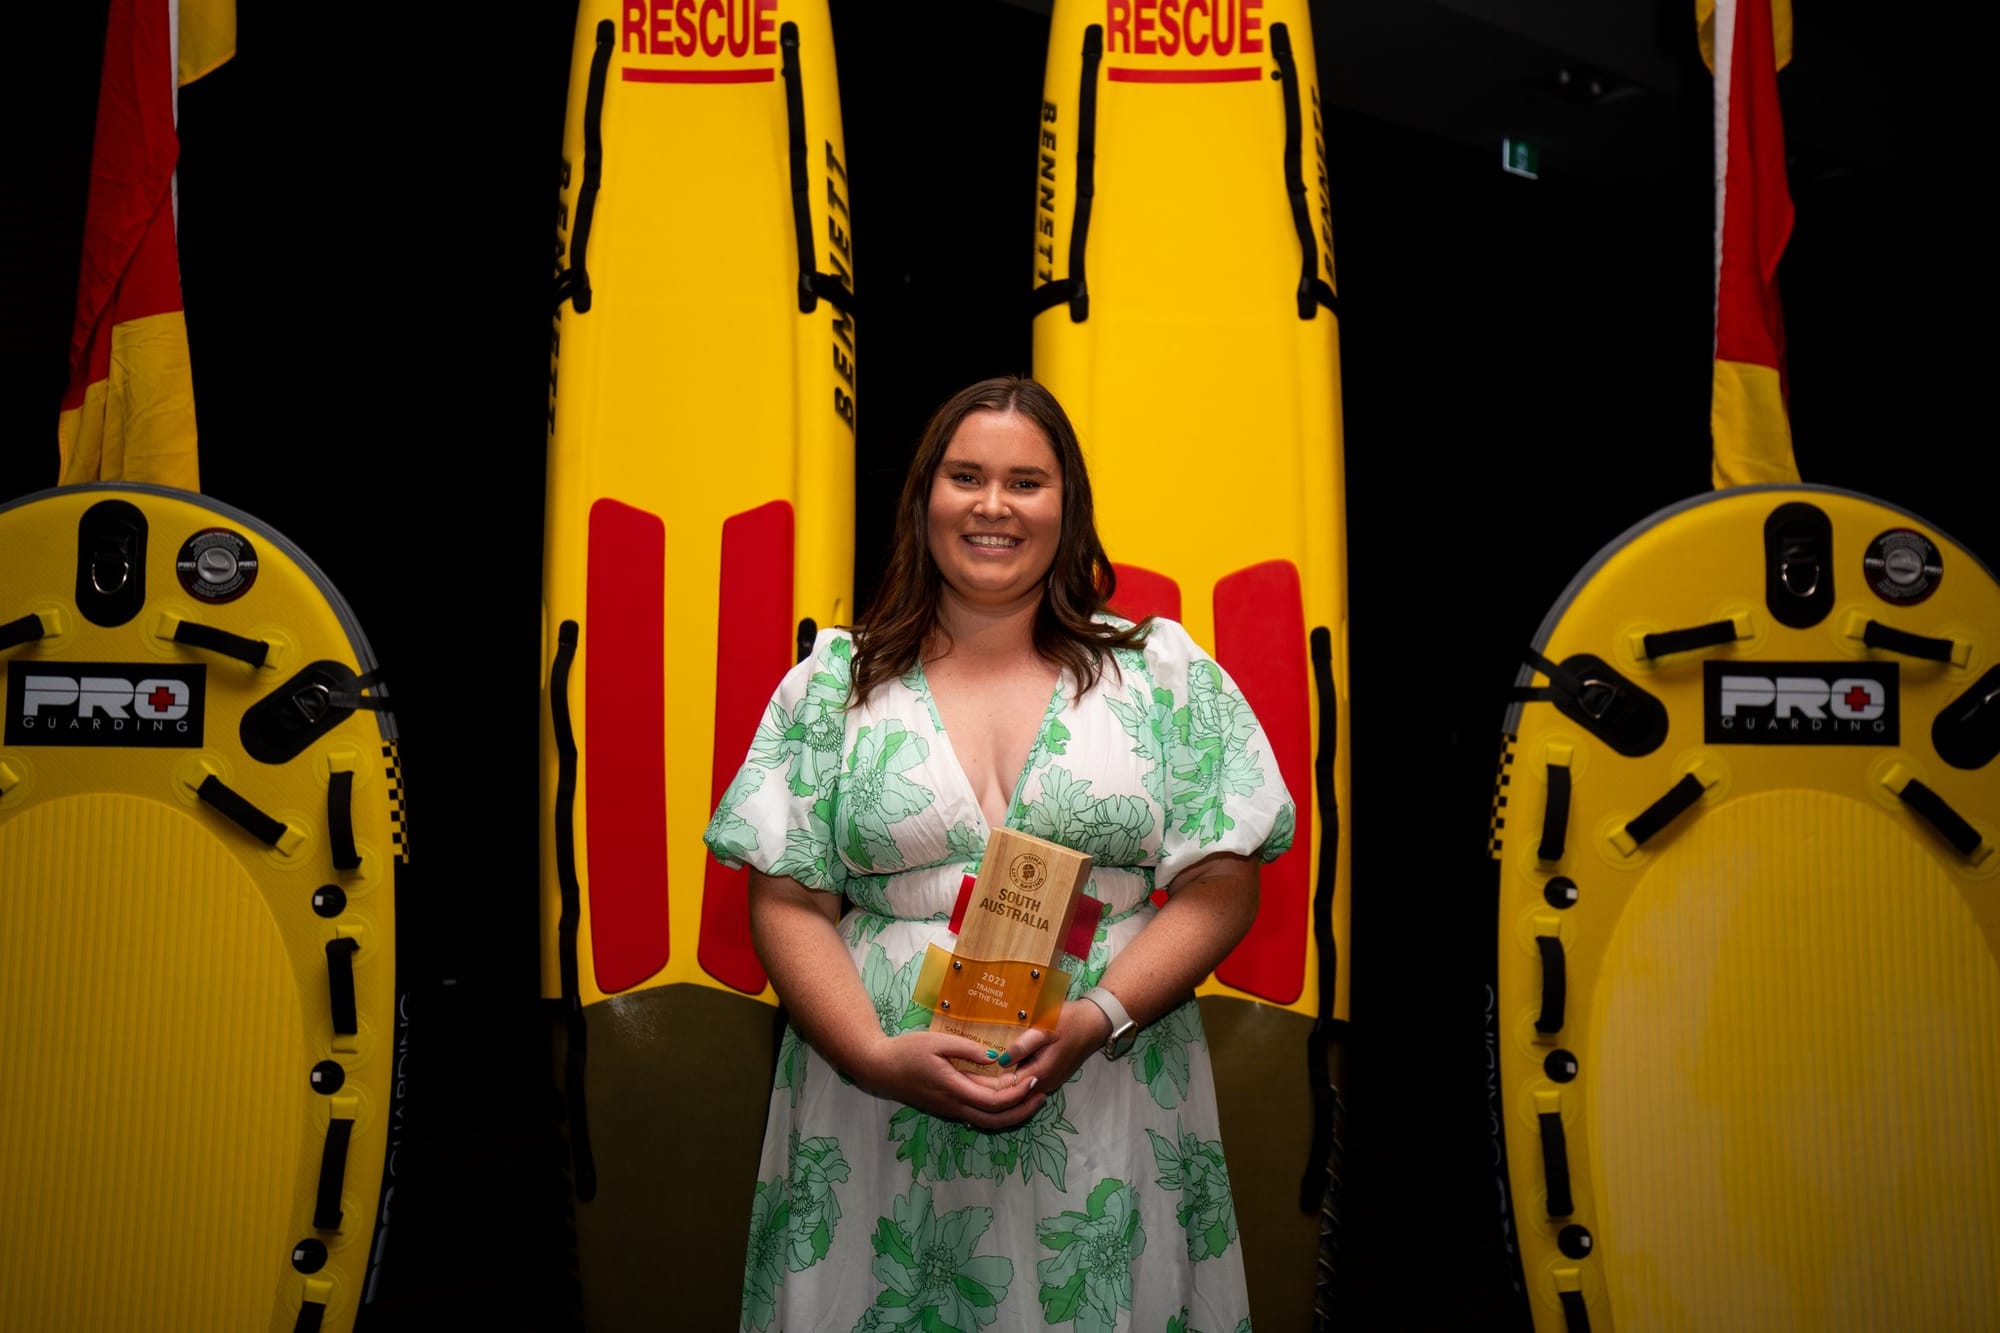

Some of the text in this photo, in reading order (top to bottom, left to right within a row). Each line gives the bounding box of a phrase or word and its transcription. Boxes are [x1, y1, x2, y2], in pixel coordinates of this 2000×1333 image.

[622, 0, 778, 57] RESCUE
[1107, 0, 1264, 56] RESCUE
[1038, 100, 1058, 284] BENNETT
[23, 675, 190, 720] PRO
[1721, 676, 1885, 719] PRO
[23, 717, 188, 733] GUARDING
[1721, 717, 1886, 732] GUARDING
[998, 888, 1042, 912] SOUTH
[979, 897, 1050, 932] AUSTRALIA
[976, 982, 1004, 998] TRAINER
[982, 972, 1006, 987] 2023
[968, 989, 1009, 1009] OF THE YEAR
[944, 1025, 982, 1043] CASSANDRA
